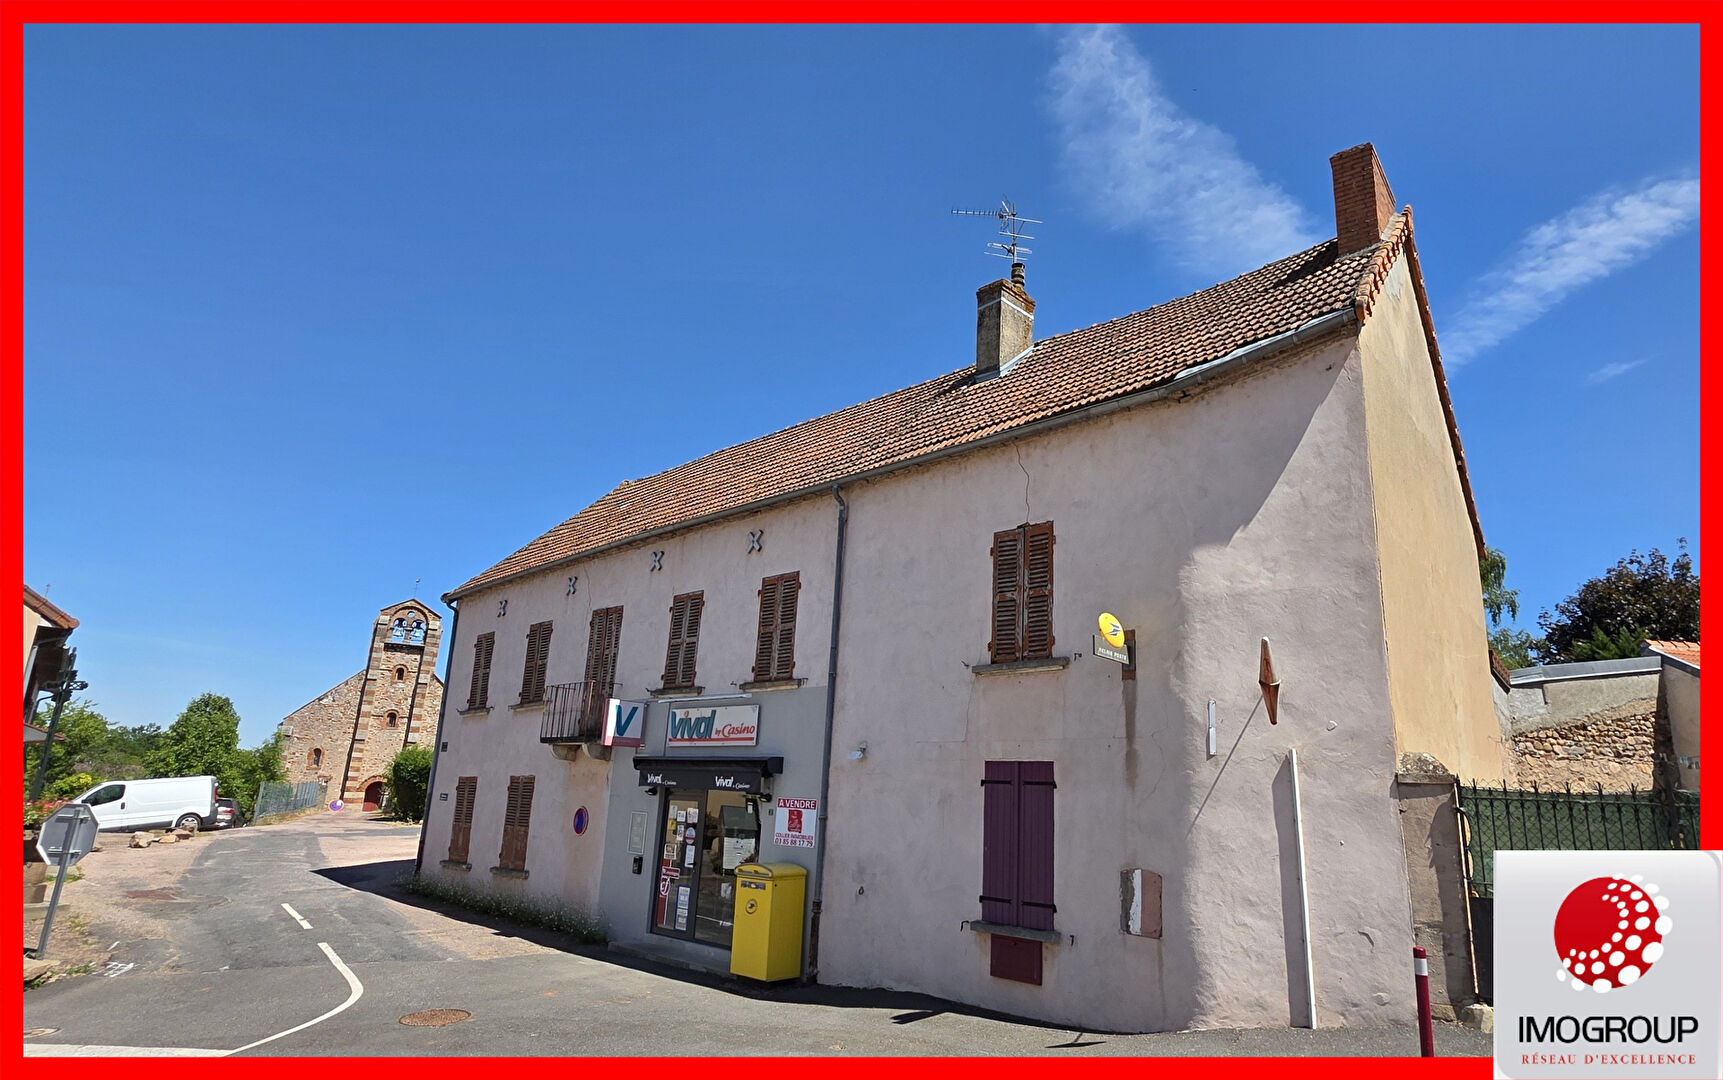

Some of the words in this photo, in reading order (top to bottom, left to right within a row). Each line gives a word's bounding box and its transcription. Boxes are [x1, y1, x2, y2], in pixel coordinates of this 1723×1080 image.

[615, 704, 639, 737] V
[670, 709, 717, 739] Vival
[722, 722, 756, 738] Casino
[715, 776, 734, 788] Vival
[779, 799, 785, 807] A
[785, 799, 815, 808] VENDRE
